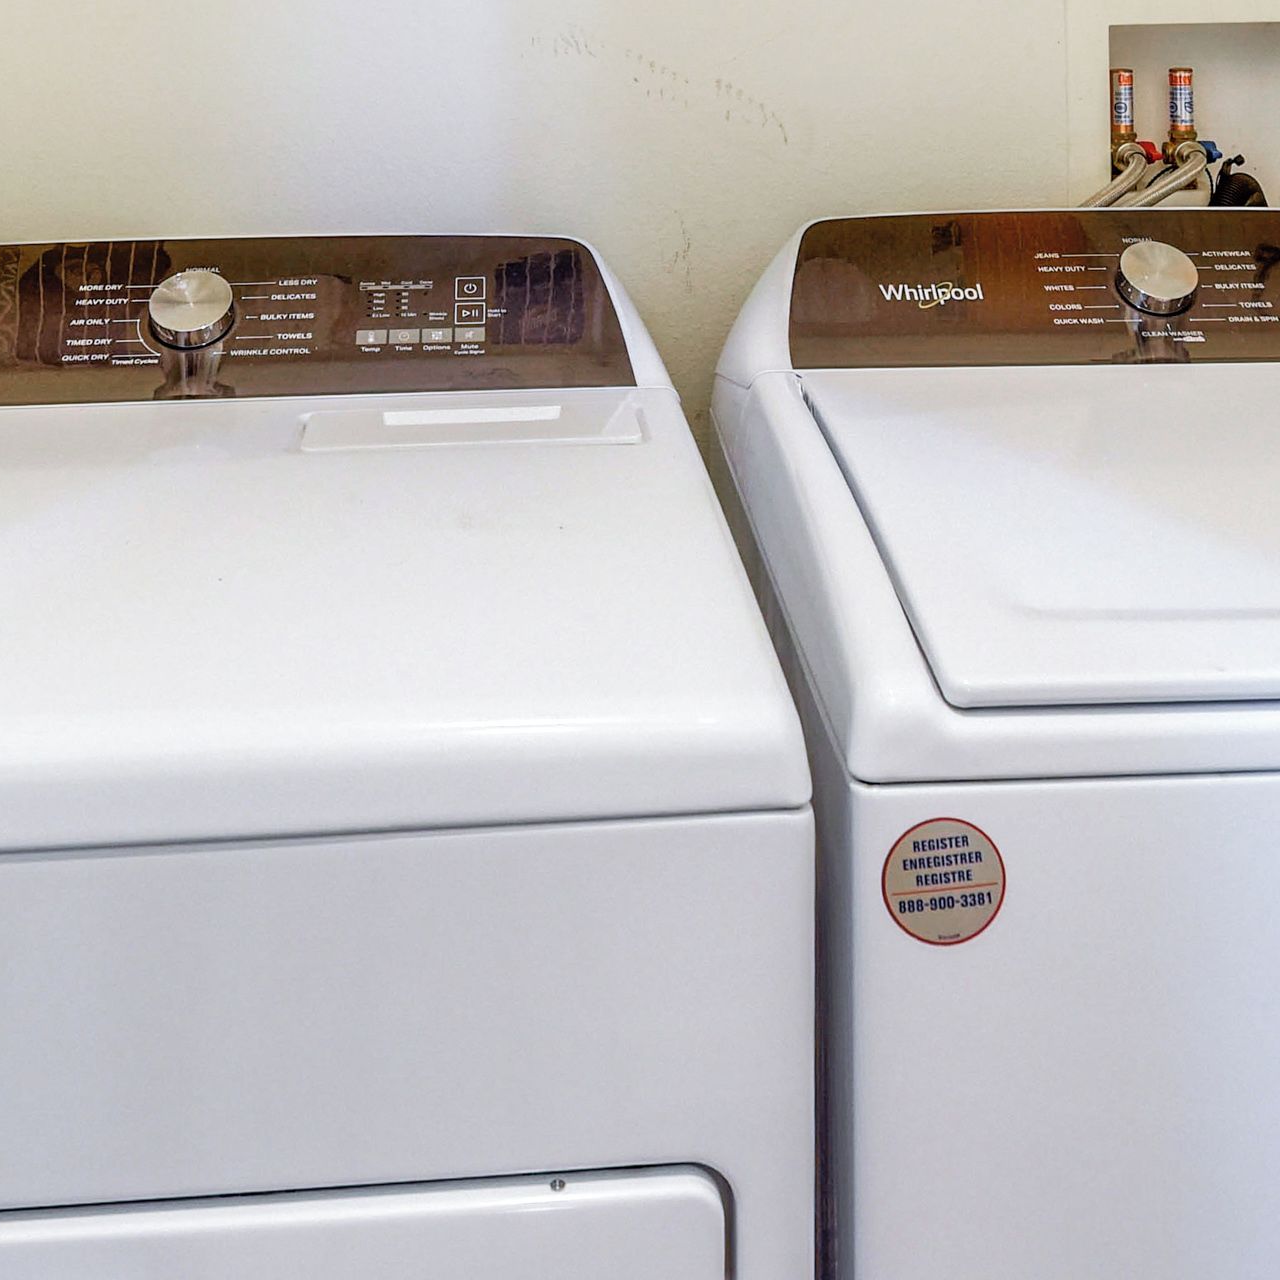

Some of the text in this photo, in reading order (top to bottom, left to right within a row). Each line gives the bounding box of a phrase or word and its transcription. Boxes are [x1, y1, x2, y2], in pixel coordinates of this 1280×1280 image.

[300, 278, 318, 286] DRY
[1214, 282, 1265, 290] BULKY ITEMS
[78, 284, 104, 292] MORE
[1044, 284, 1074, 292] WHITES
[879, 282, 984, 308] Whirlpool
[75, 298, 129, 306] HEAVY DUTY
[288, 312, 315, 320] ITEMS
[85, 318, 110, 326] ONLY
[276, 332, 313, 340] TOWELS
[1141, 330, 1168, 338] CLEAN
[230, 348, 311, 356] WRINKLE CONTROL
[422, 344, 451, 352] Options
[912, 835, 970, 852] REGISTER
[902, 851, 983, 871] ENREGISTRER
[916, 869, 973, 887] REGISTRE
[898, 892, 992, 914] 888-900-3381
